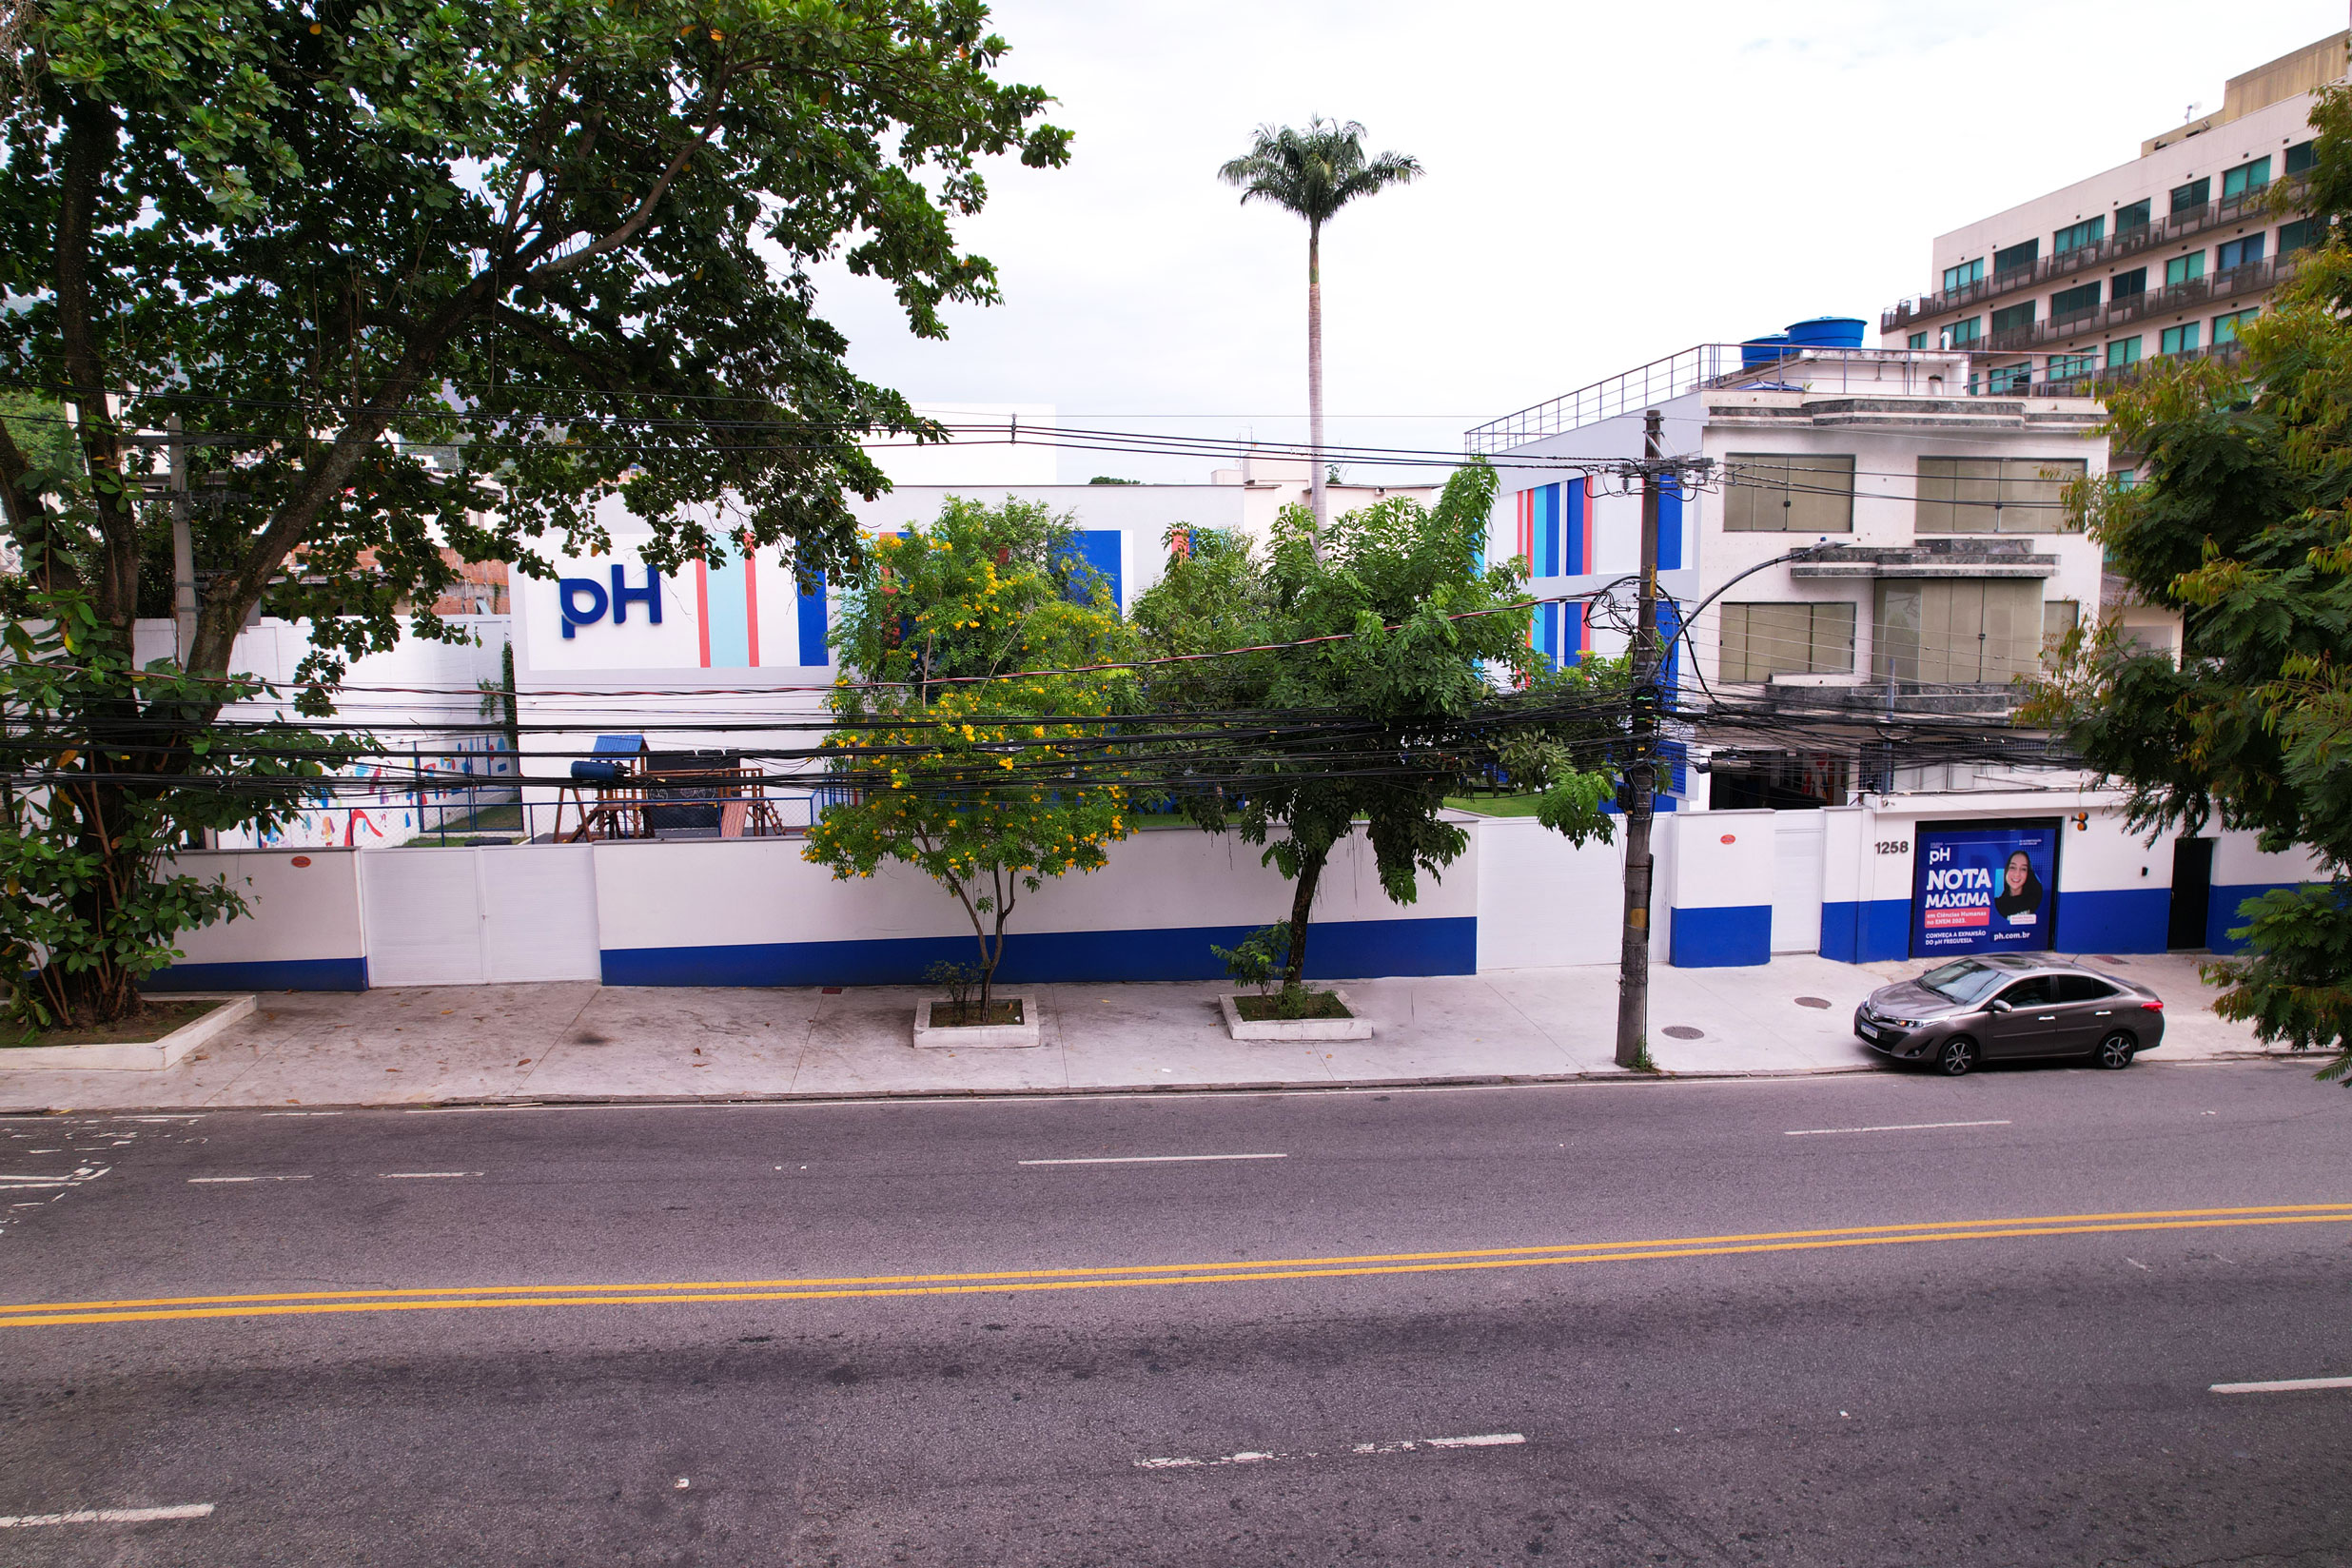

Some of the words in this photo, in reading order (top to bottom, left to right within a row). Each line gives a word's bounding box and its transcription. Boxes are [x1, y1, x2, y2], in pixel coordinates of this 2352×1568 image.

[559, 564, 662, 638] pH
[1874, 841, 1909, 854] 1258
[1929, 847, 1950, 865] pH
[1926, 868, 1992, 891] NOTA
[1925, 891, 1990, 909] MÁXIMA
[1993, 931, 2030, 942] ph.com.br
